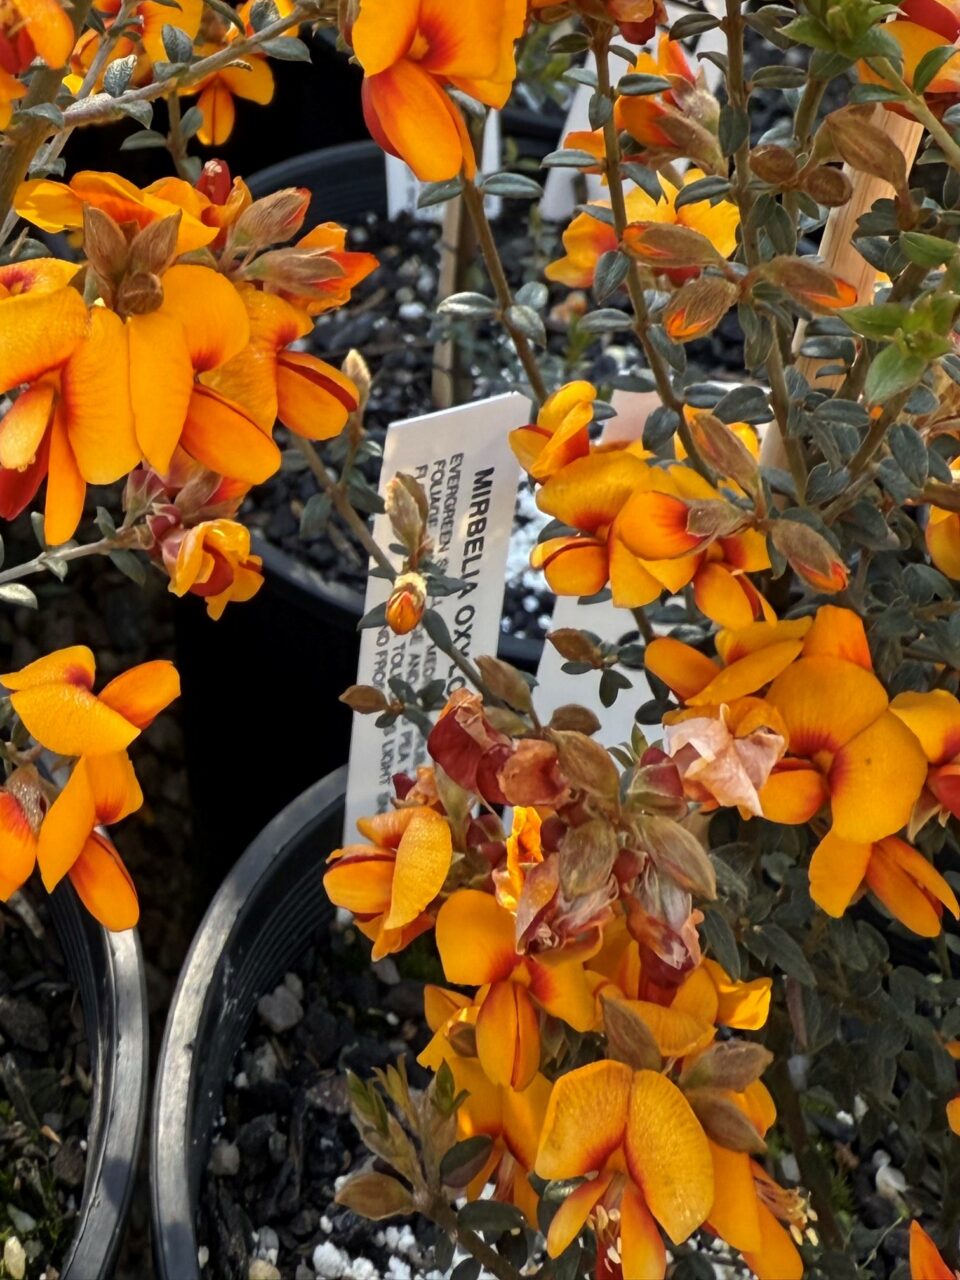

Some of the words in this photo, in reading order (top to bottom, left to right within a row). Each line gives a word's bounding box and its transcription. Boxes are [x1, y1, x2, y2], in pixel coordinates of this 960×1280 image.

[438, 452, 464, 553] EVERGREEN
[457, 467, 495, 600] MIRBELIA
[446, 605, 476, 696] OXYLO
